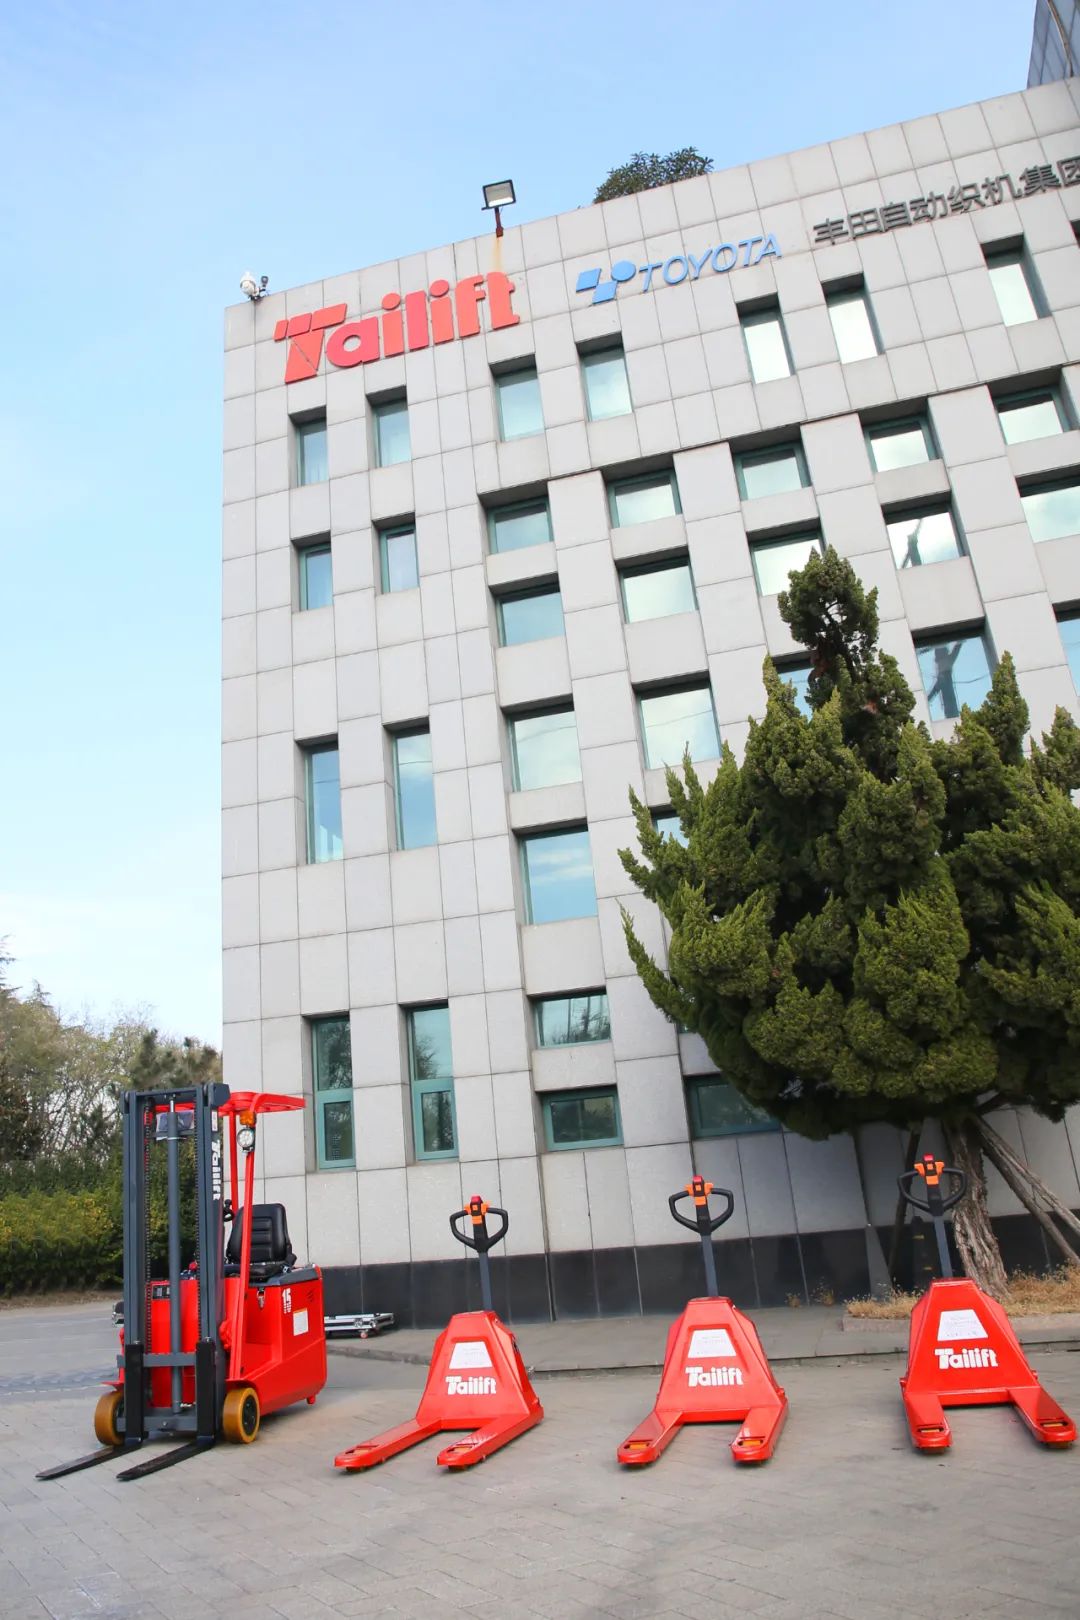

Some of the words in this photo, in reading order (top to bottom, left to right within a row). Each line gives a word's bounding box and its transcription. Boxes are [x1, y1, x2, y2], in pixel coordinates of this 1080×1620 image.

[638, 232, 782, 293] TOYOTA
[273, 271, 521, 384] Tailift
[211, 1139, 221, 1201] Tailift
[685, 1366, 744, 1387] Tailift
[934, 1347, 999, 1369] Tailift
[445, 1375, 497, 1395] Tailift
